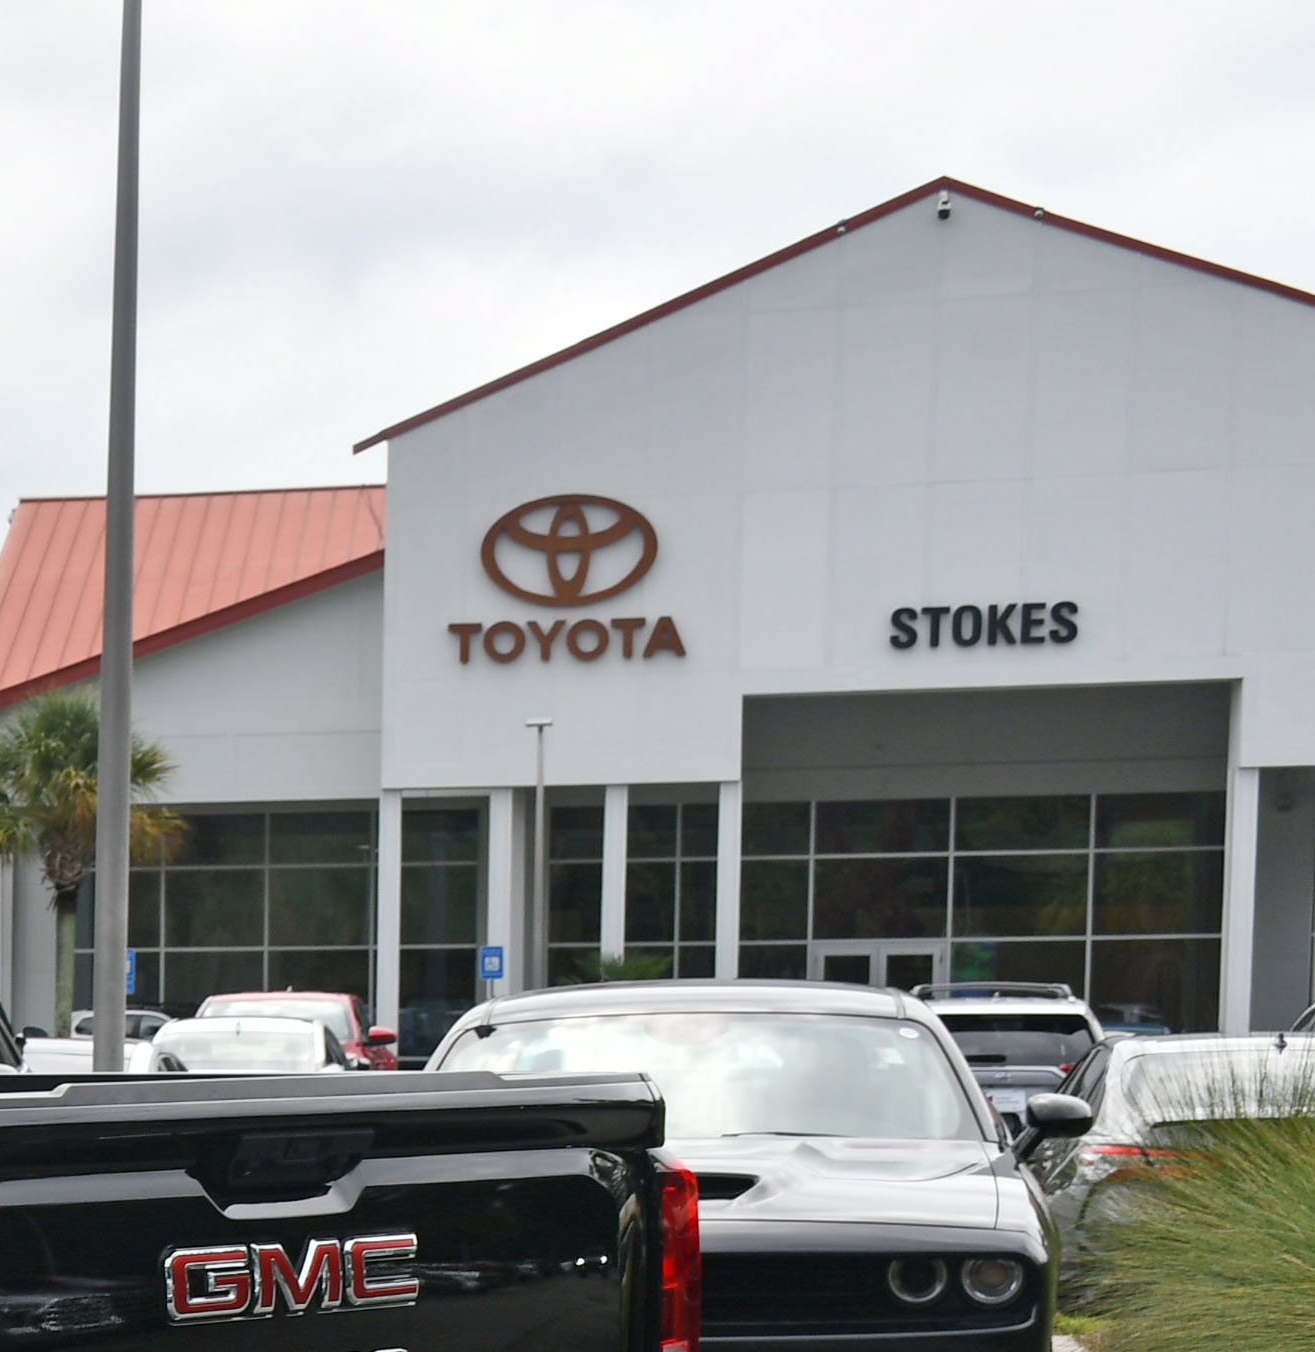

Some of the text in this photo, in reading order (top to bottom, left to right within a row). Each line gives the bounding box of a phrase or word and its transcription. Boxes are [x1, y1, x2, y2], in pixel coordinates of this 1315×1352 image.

[448, 616, 687, 664] TOYOTA
[889, 601, 1079, 650] STOKES
[164, 1234, 419, 1325] GMC
